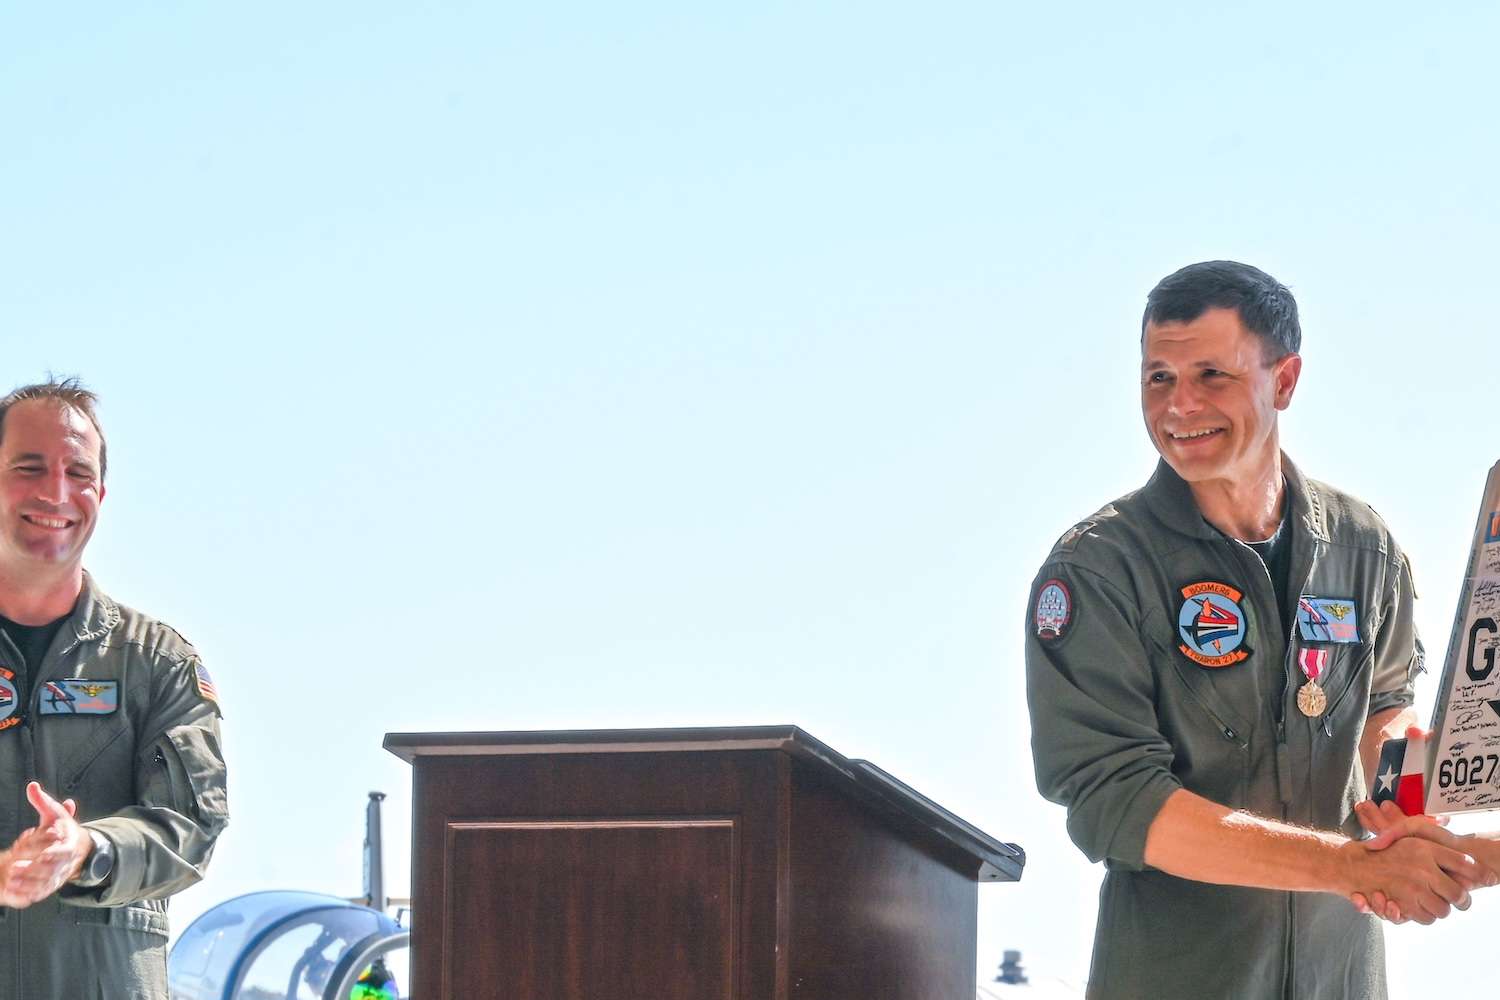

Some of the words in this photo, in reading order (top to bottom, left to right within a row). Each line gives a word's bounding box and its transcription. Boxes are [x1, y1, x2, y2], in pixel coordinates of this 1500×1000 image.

[1189, 583, 1231, 596] BOOMERS
[1222, 654, 1234, 664] 27
[1465, 617, 1497, 681] G
[1438, 754, 1499, 788] 6027
